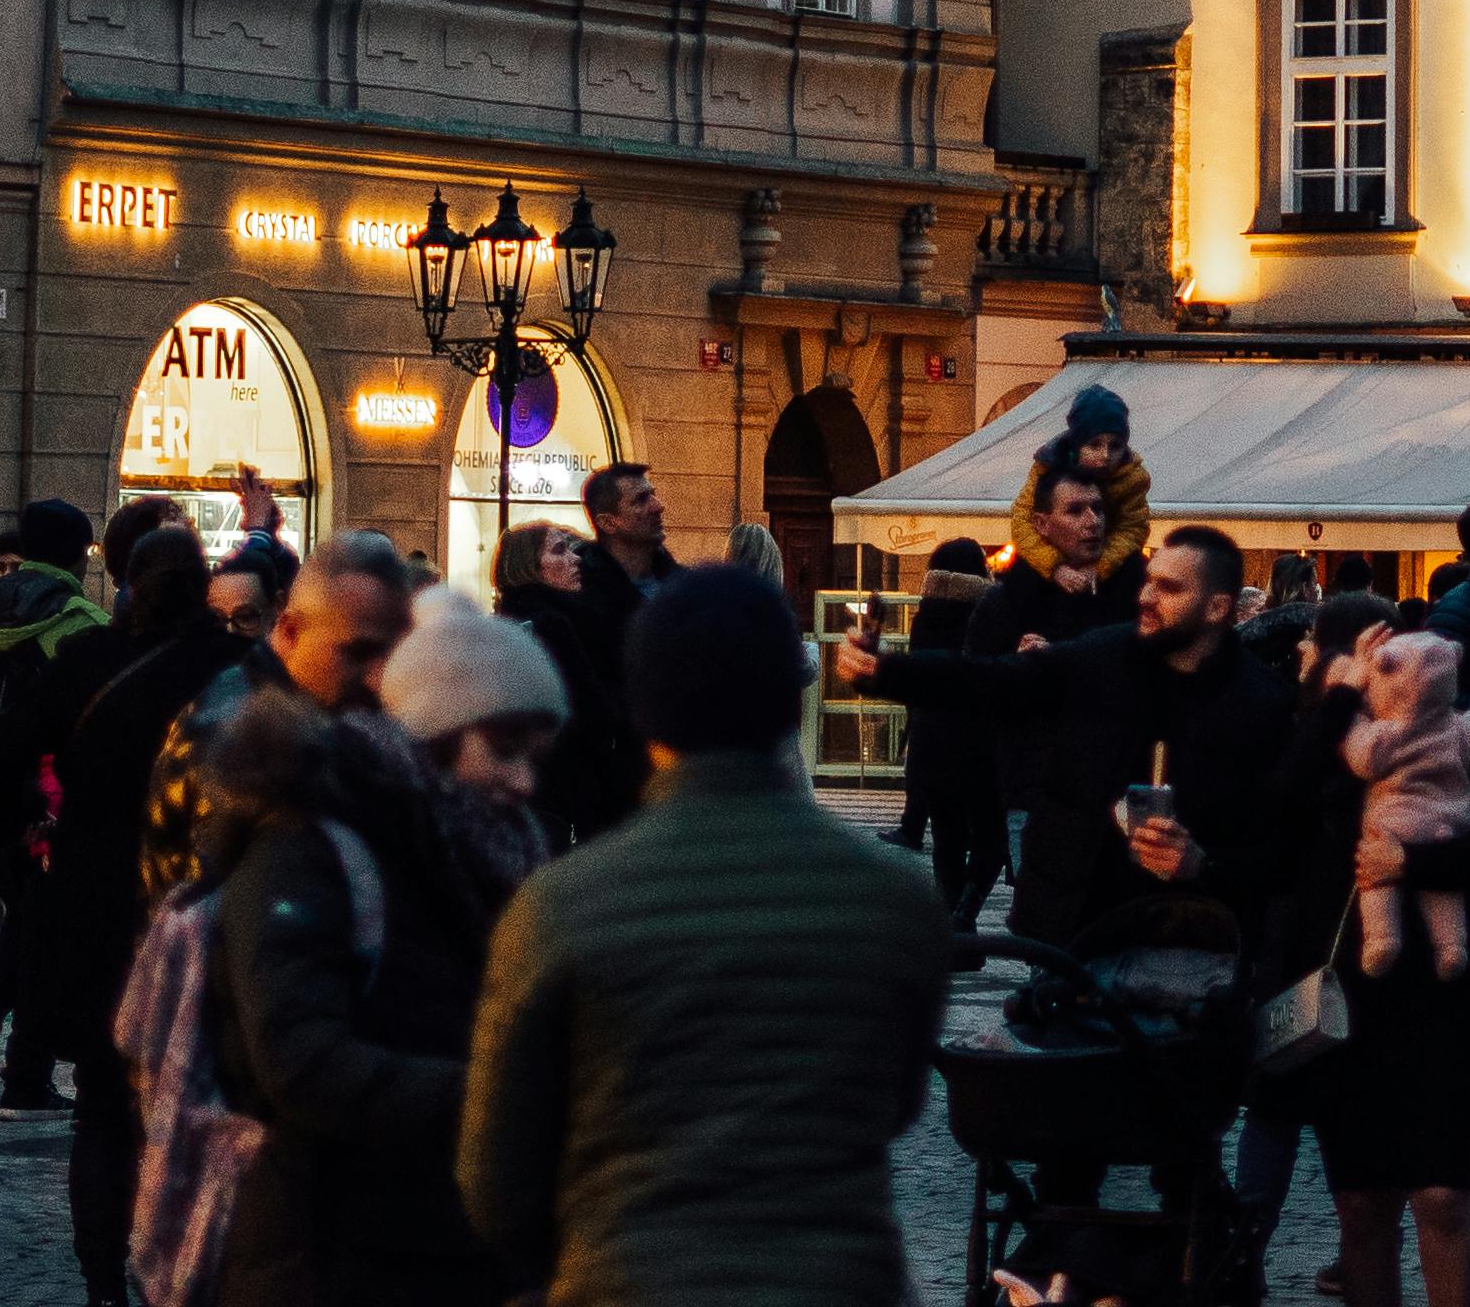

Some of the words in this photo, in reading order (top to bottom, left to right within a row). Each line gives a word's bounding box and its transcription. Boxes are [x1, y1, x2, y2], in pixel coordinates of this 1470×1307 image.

[75, 180, 178, 229] ERPET
[241, 210, 322, 242] CRYSTAL
[162, 327, 246, 380] ATM
[231, 382, 258, 402] here
[452, 450, 500, 470] OHEMIA
[509, 452, 541, 469] ZECH
[490, 475, 523, 495] SCE
